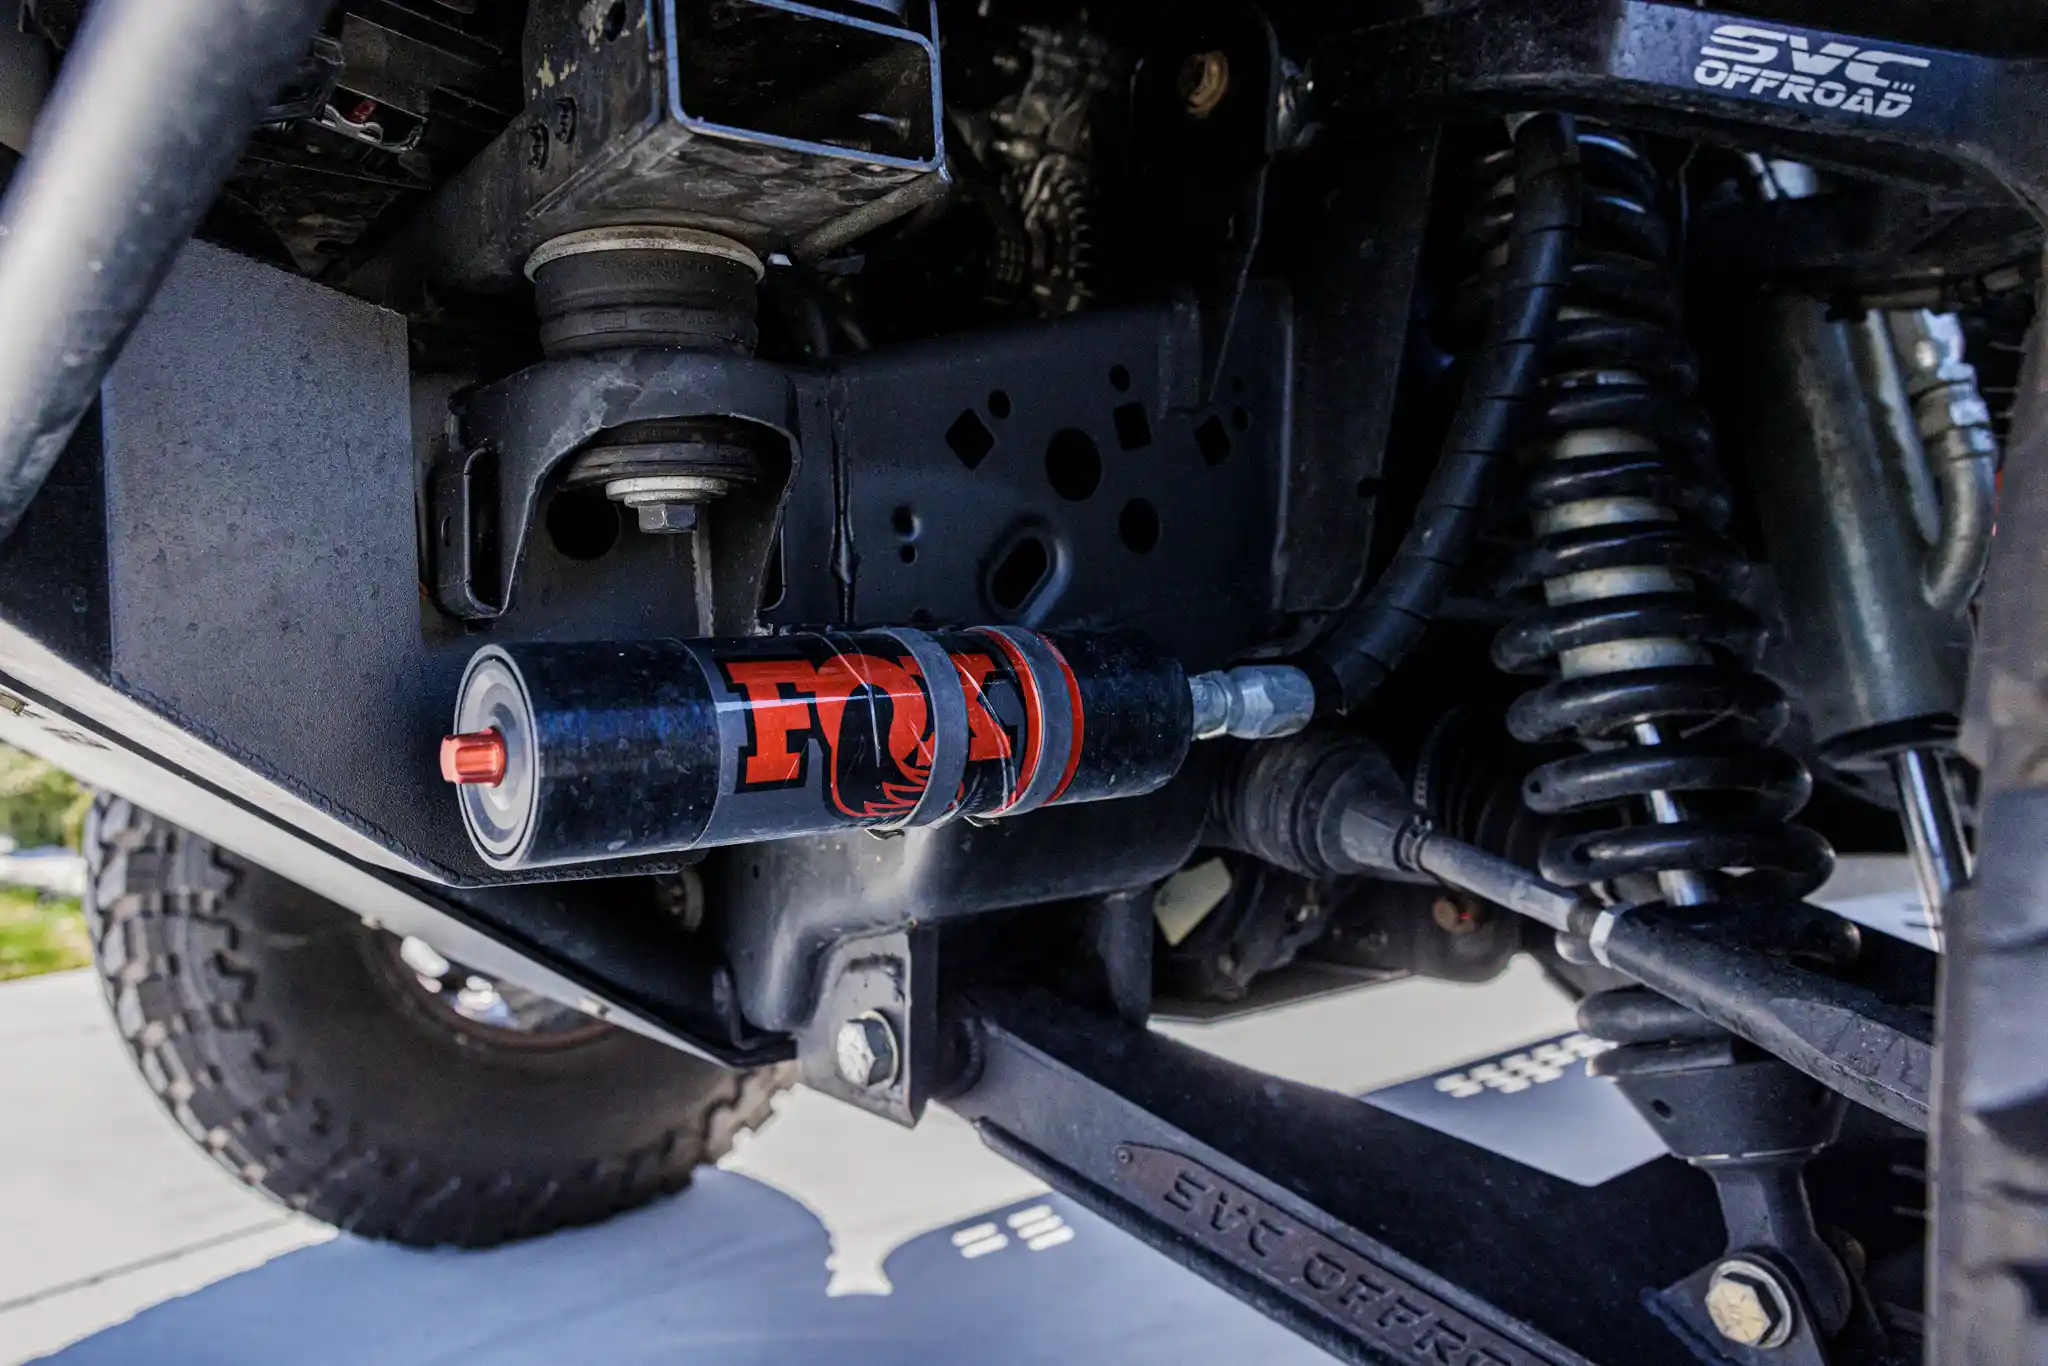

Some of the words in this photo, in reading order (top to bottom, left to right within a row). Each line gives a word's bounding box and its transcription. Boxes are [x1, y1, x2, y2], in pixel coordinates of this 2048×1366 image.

[1700, 24, 1931, 88] SVC
[1694, 60, 1913, 118] OFFROAD
[1164, 1171, 1284, 1257] SVC
